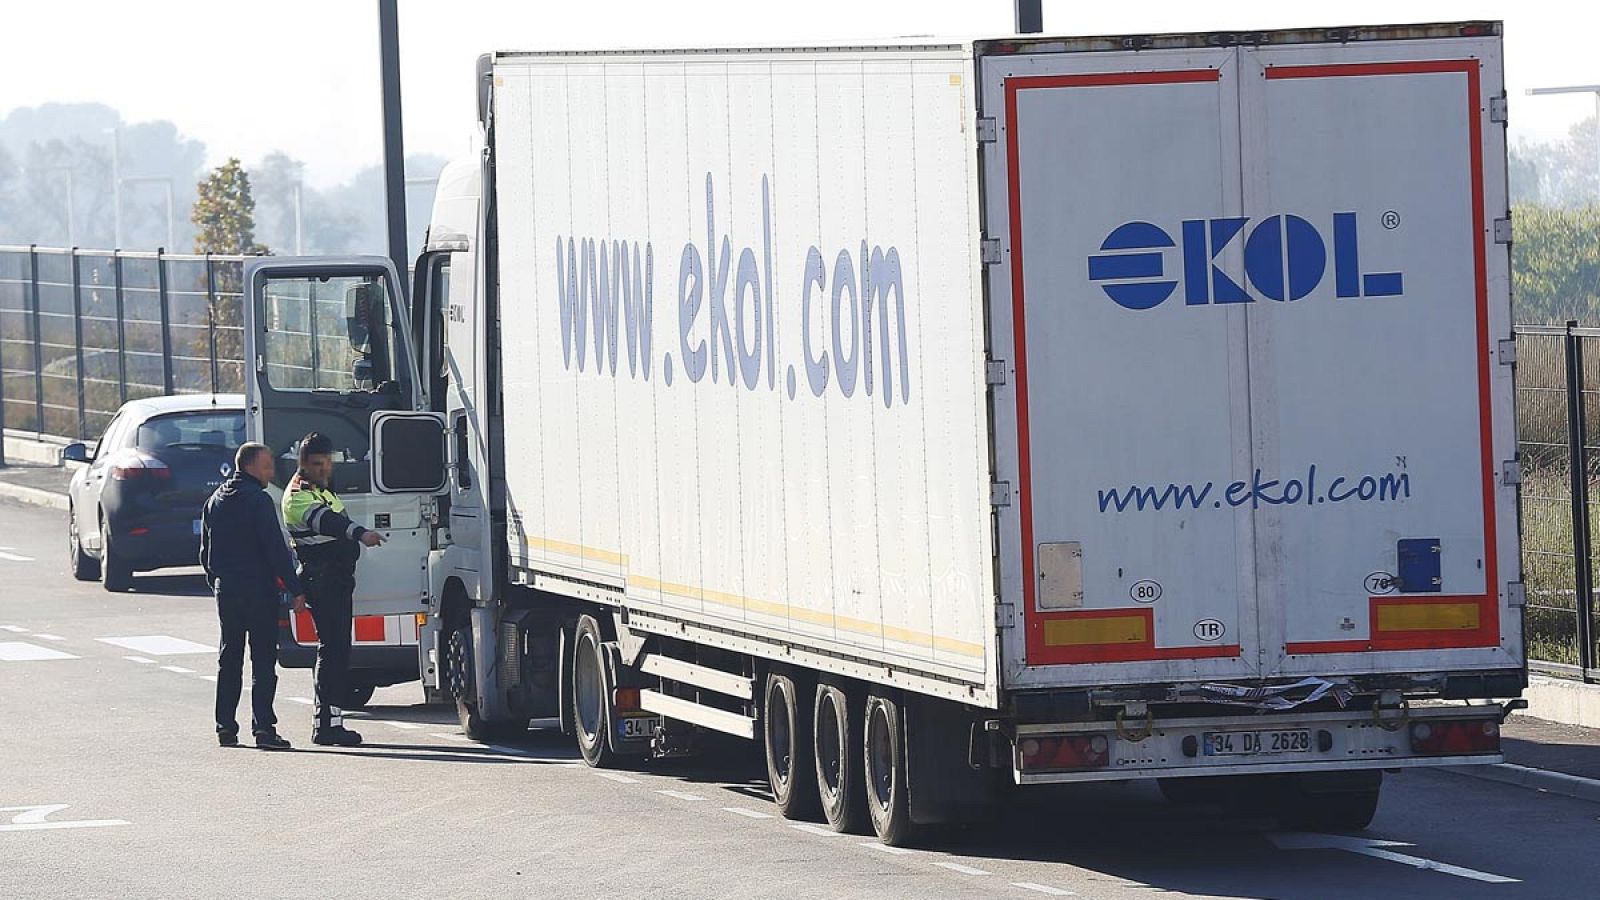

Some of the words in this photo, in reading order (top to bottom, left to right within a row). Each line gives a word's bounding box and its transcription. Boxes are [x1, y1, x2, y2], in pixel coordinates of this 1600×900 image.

[1087, 211, 1404, 310] EKOL
[556, 171, 909, 409] www.ekol.com
[1097, 464, 1410, 512] www.ekol.com
[1137, 586, 1154, 598] 80
[1199, 623, 1219, 637] TR
[624, 719, 642, 735] 34
[1215, 734, 1233, 752] 34
[1243, 733, 1262, 752] DA
[1271, 731, 1309, 750] 2628
